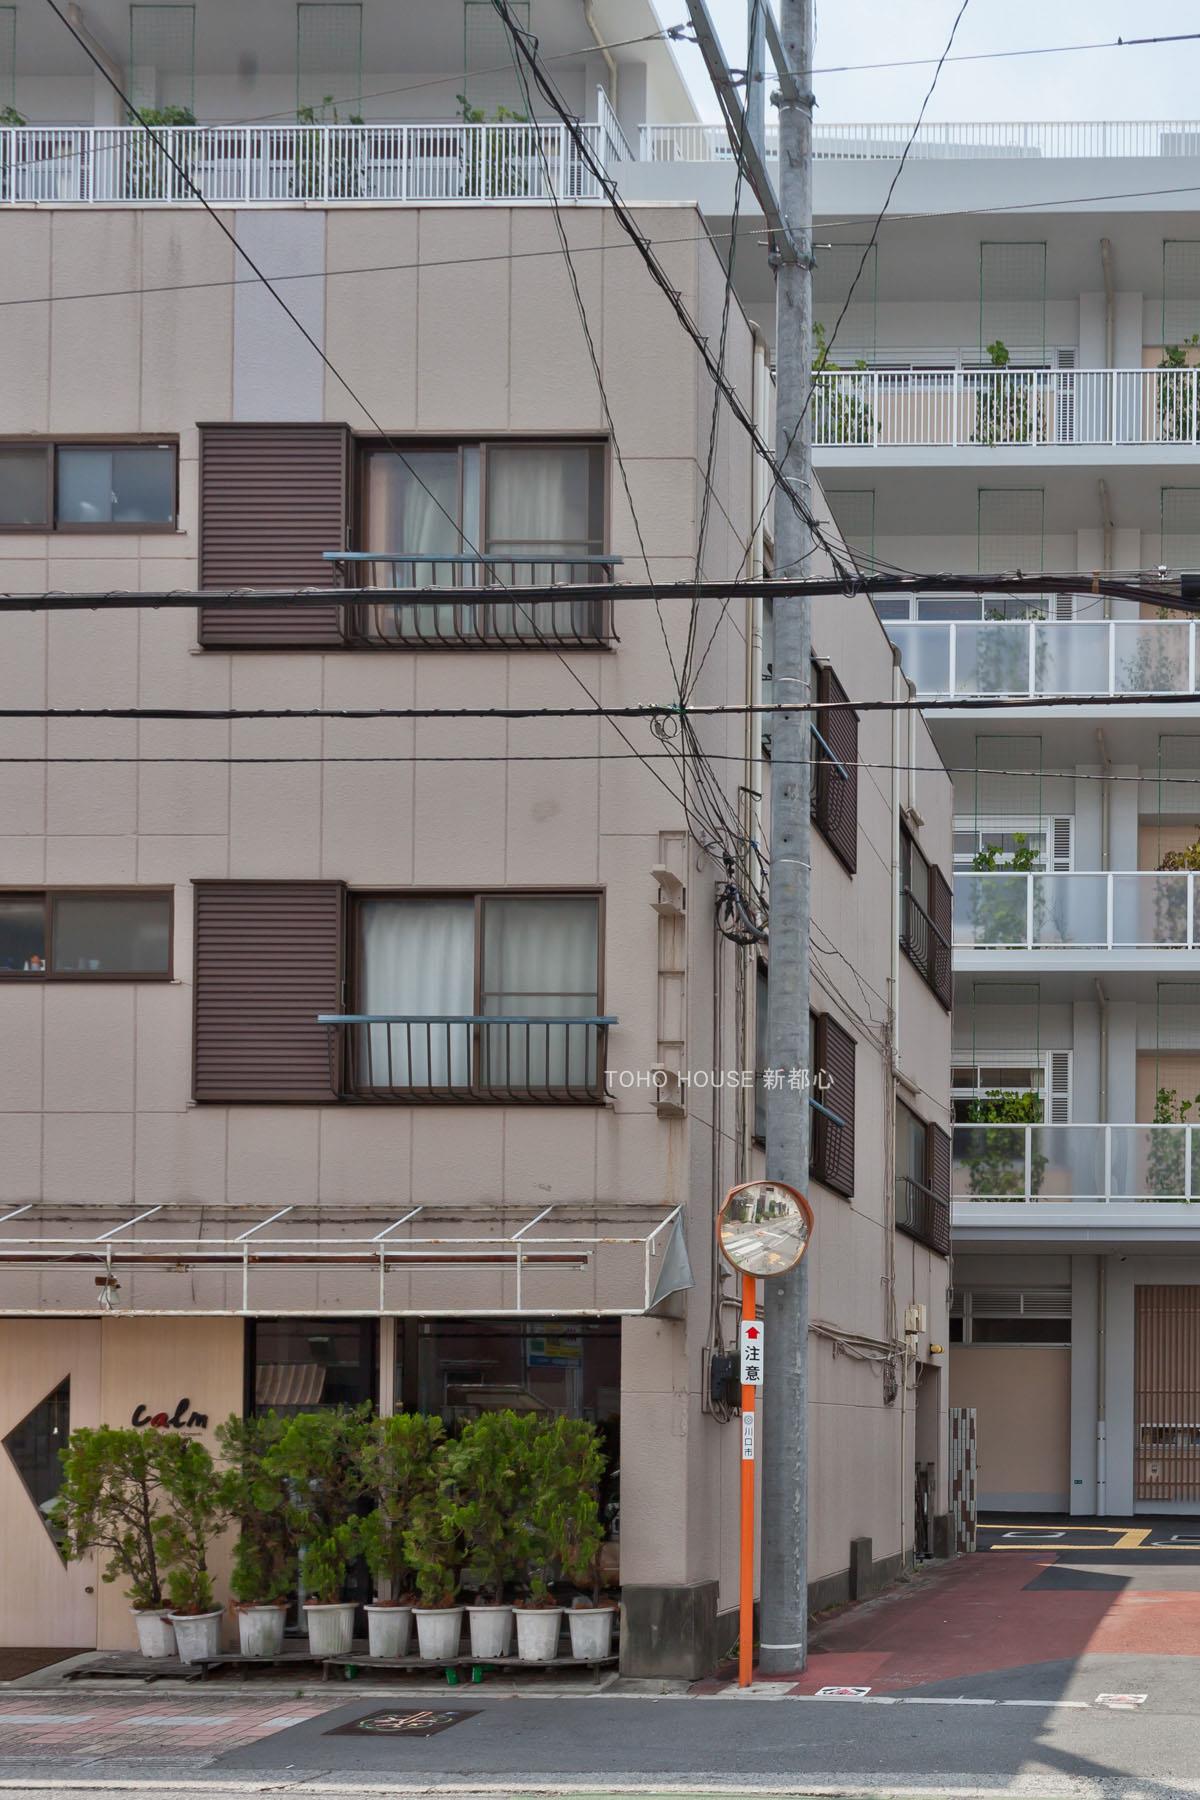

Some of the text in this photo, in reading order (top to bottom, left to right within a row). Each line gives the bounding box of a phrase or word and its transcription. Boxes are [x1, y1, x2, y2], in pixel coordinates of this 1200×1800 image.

[744, 1345, 761, 1381] 注意
[744, 1426, 754, 1457] 川口市
